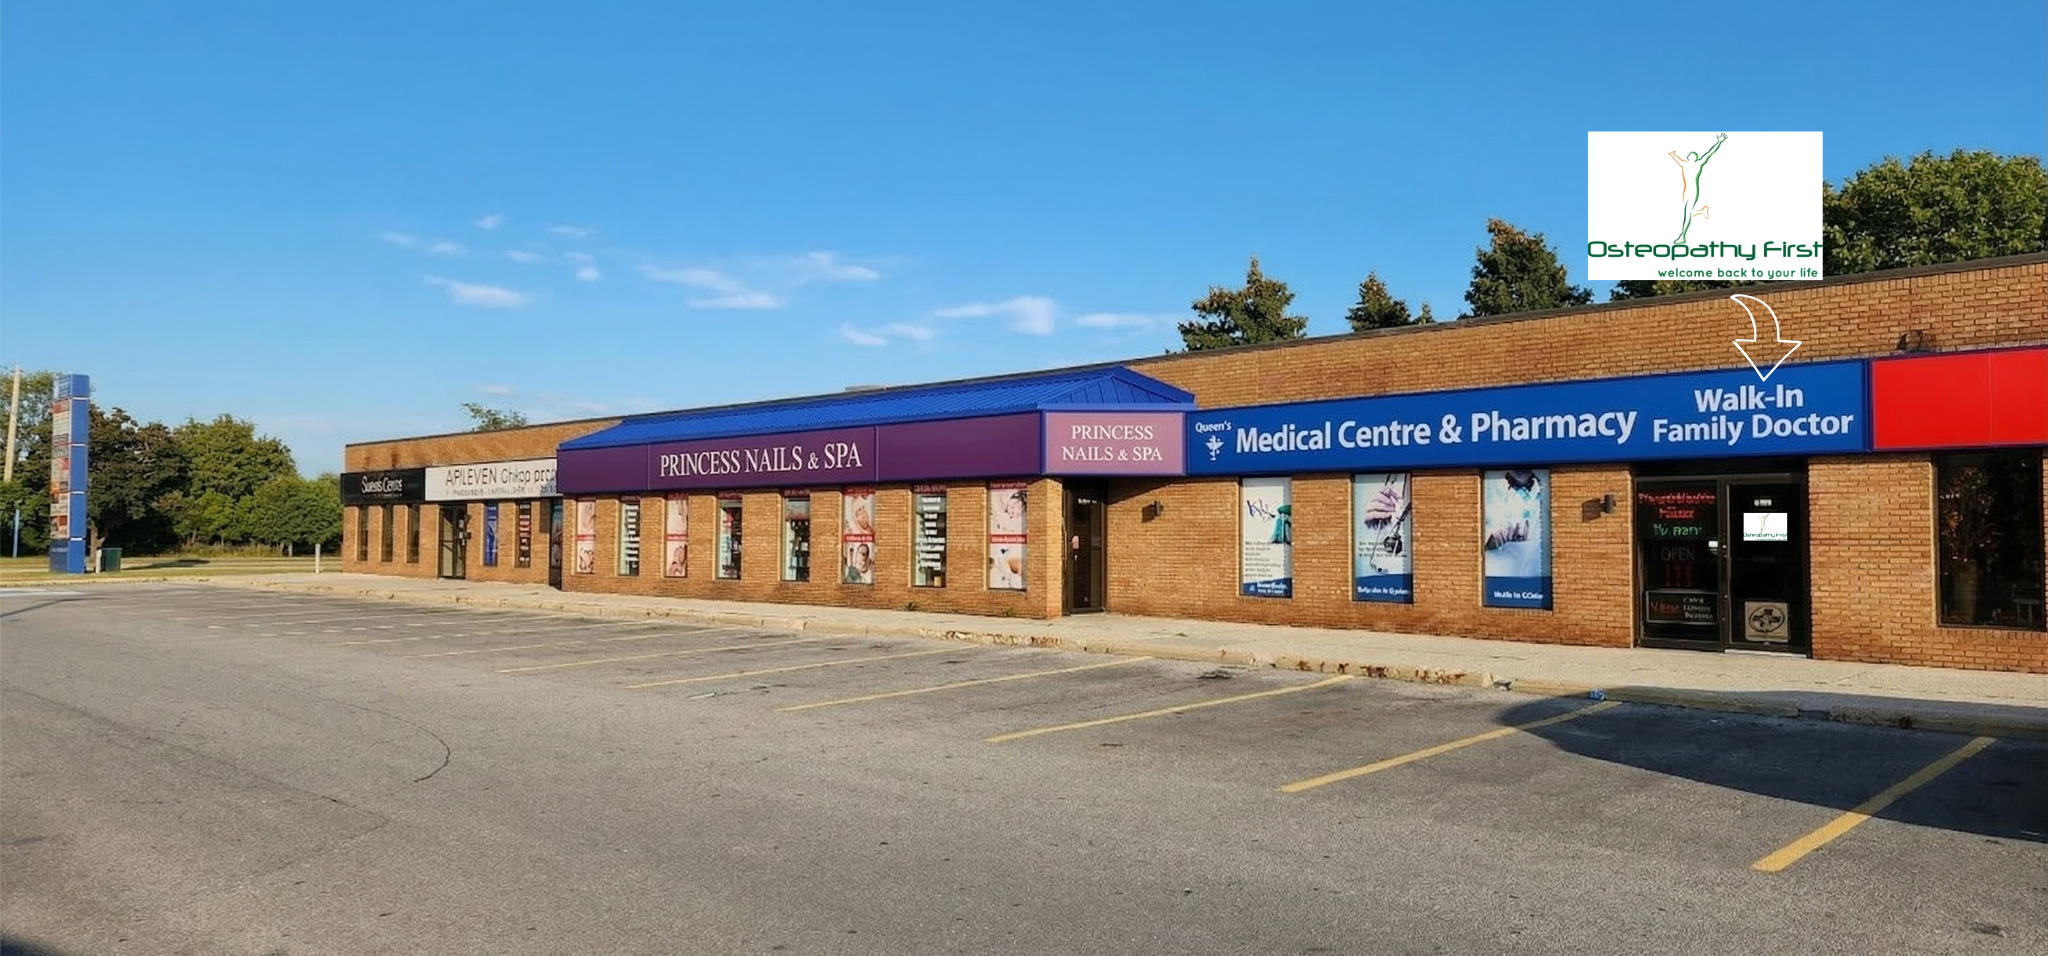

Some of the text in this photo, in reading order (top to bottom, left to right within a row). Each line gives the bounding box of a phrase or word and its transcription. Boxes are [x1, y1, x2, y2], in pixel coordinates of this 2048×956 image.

[1694, 384, 1804, 413] Walk-In
[1071, 425, 1154, 440] PRINCESS
[1195, 420, 1232, 434] Queen's
[1236, 410, 1638, 453] Medical Centre & Pharmacy
[1653, 413, 1854, 446] Family Doctor
[659, 442, 863, 477] PRINCESS NAILS & SPA
[1062, 446, 1163, 462] NAILS & SPA
[1661, 548, 1695, 560] OPEN
